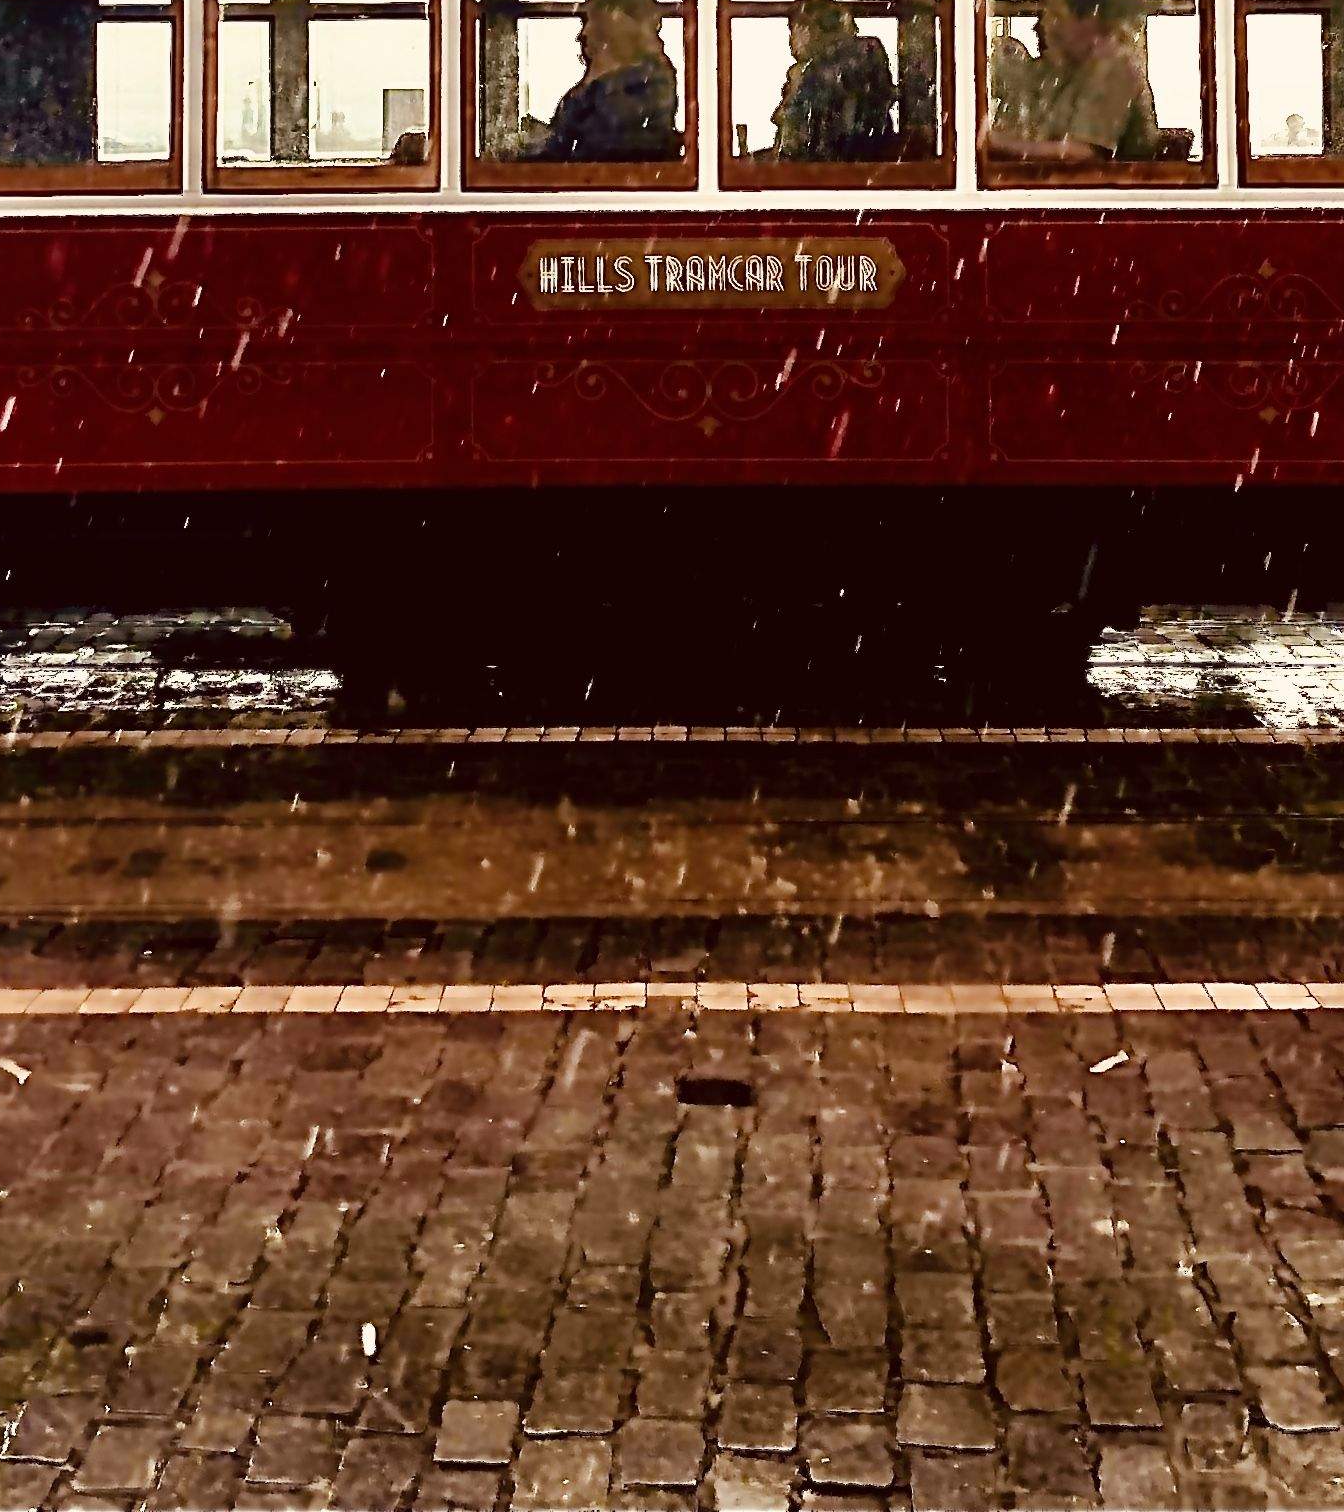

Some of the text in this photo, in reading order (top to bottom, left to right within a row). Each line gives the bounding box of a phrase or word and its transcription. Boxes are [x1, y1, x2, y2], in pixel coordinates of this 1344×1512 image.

[539, 254, 878, 294] HILLS TRAMCAR TOUR
